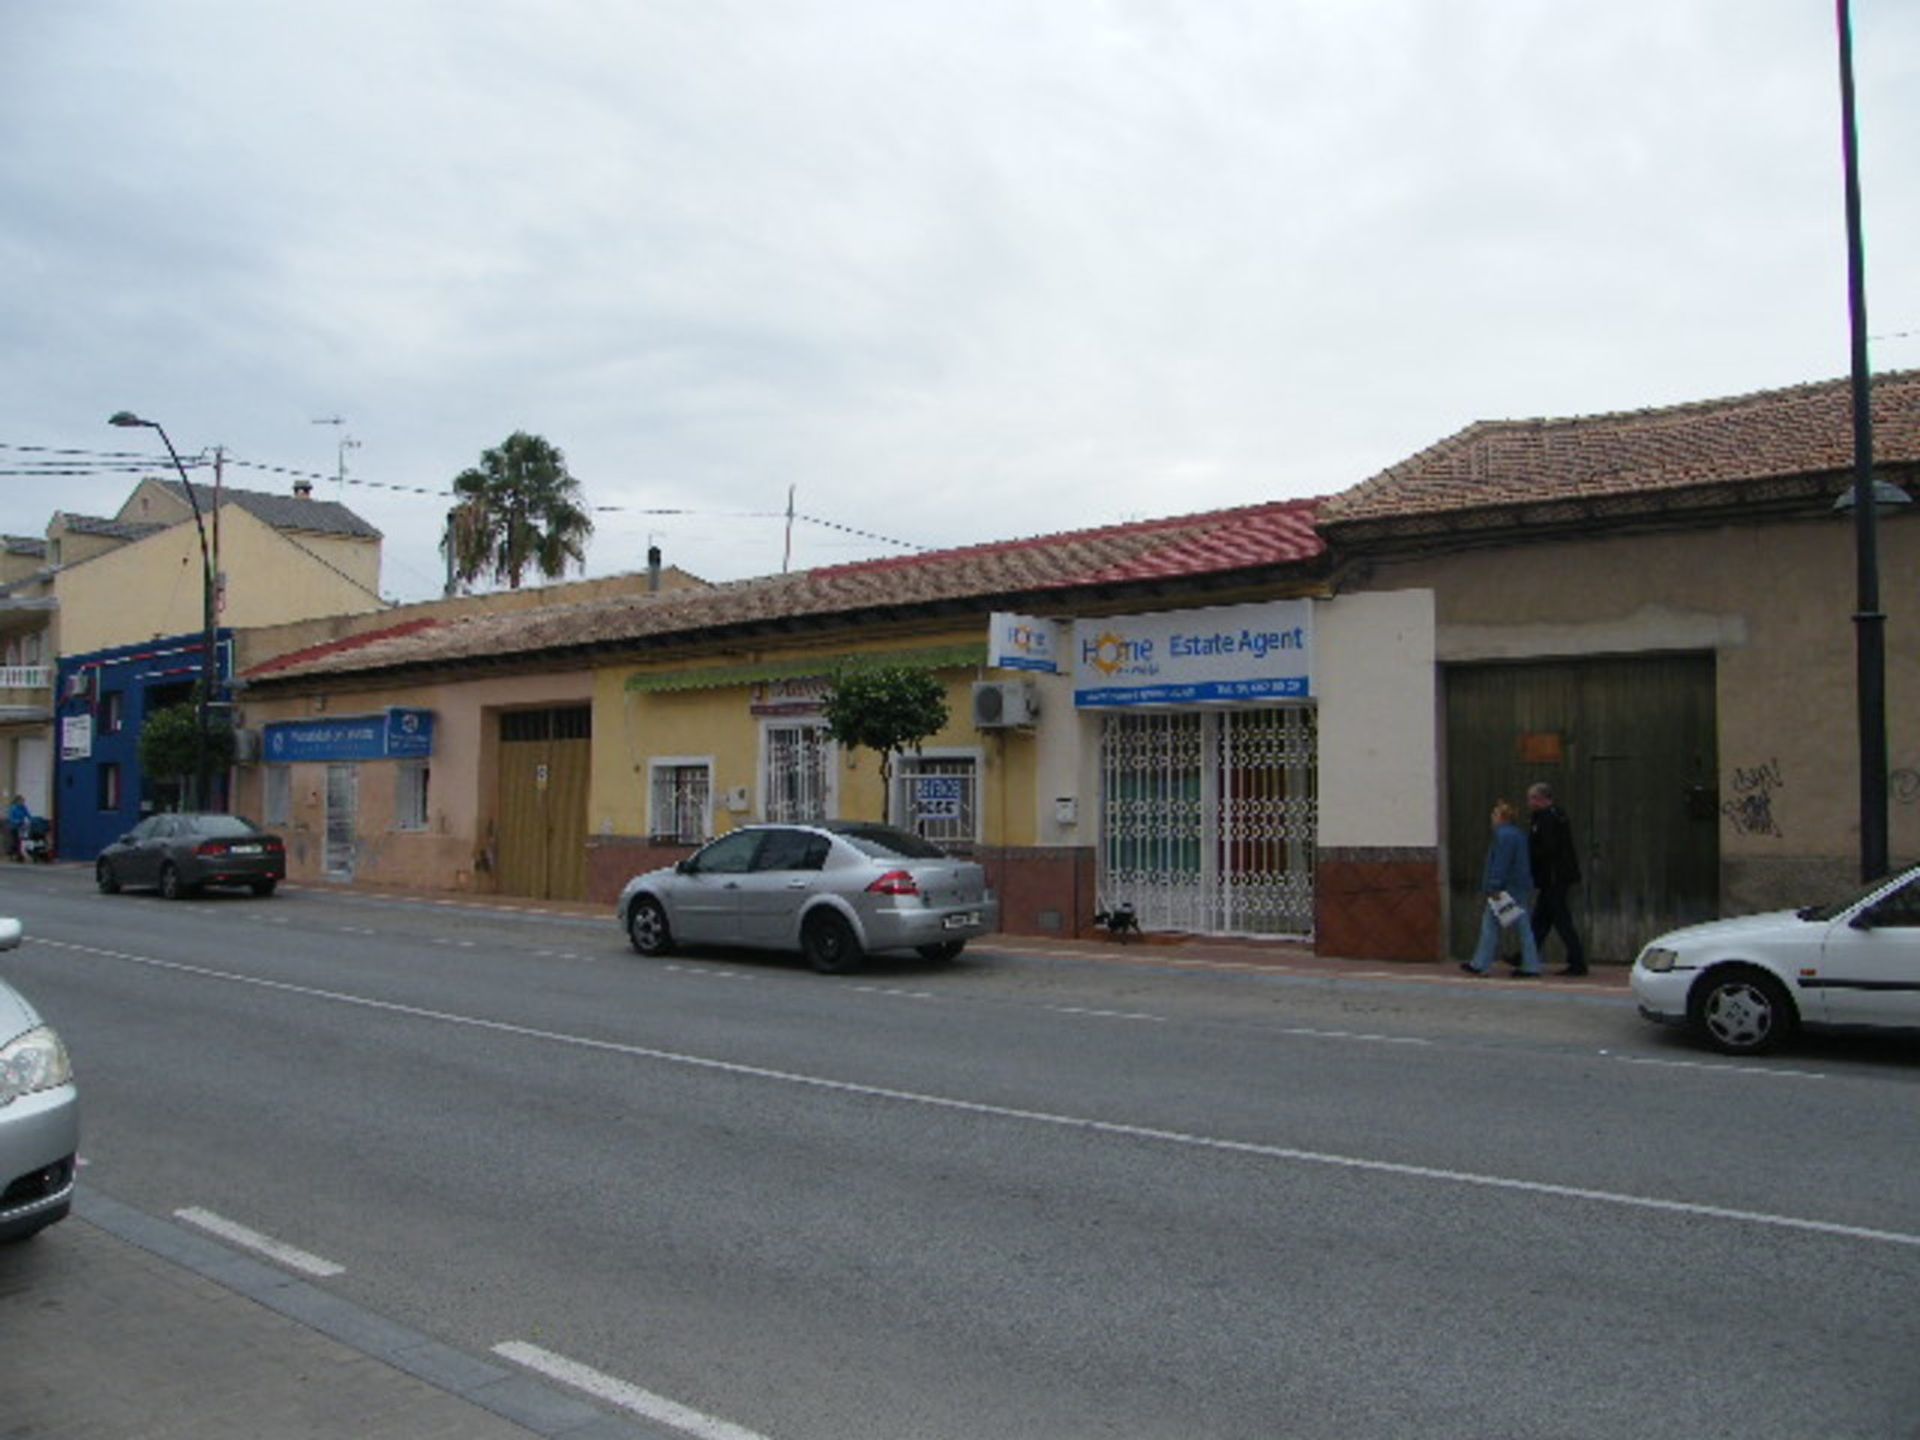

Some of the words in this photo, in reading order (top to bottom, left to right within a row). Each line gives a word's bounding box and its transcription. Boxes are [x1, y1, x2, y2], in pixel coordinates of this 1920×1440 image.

[1082, 634, 1154, 667] Home
[1169, 633, 1234, 656] Estate
[1239, 627, 1302, 658] Agent
